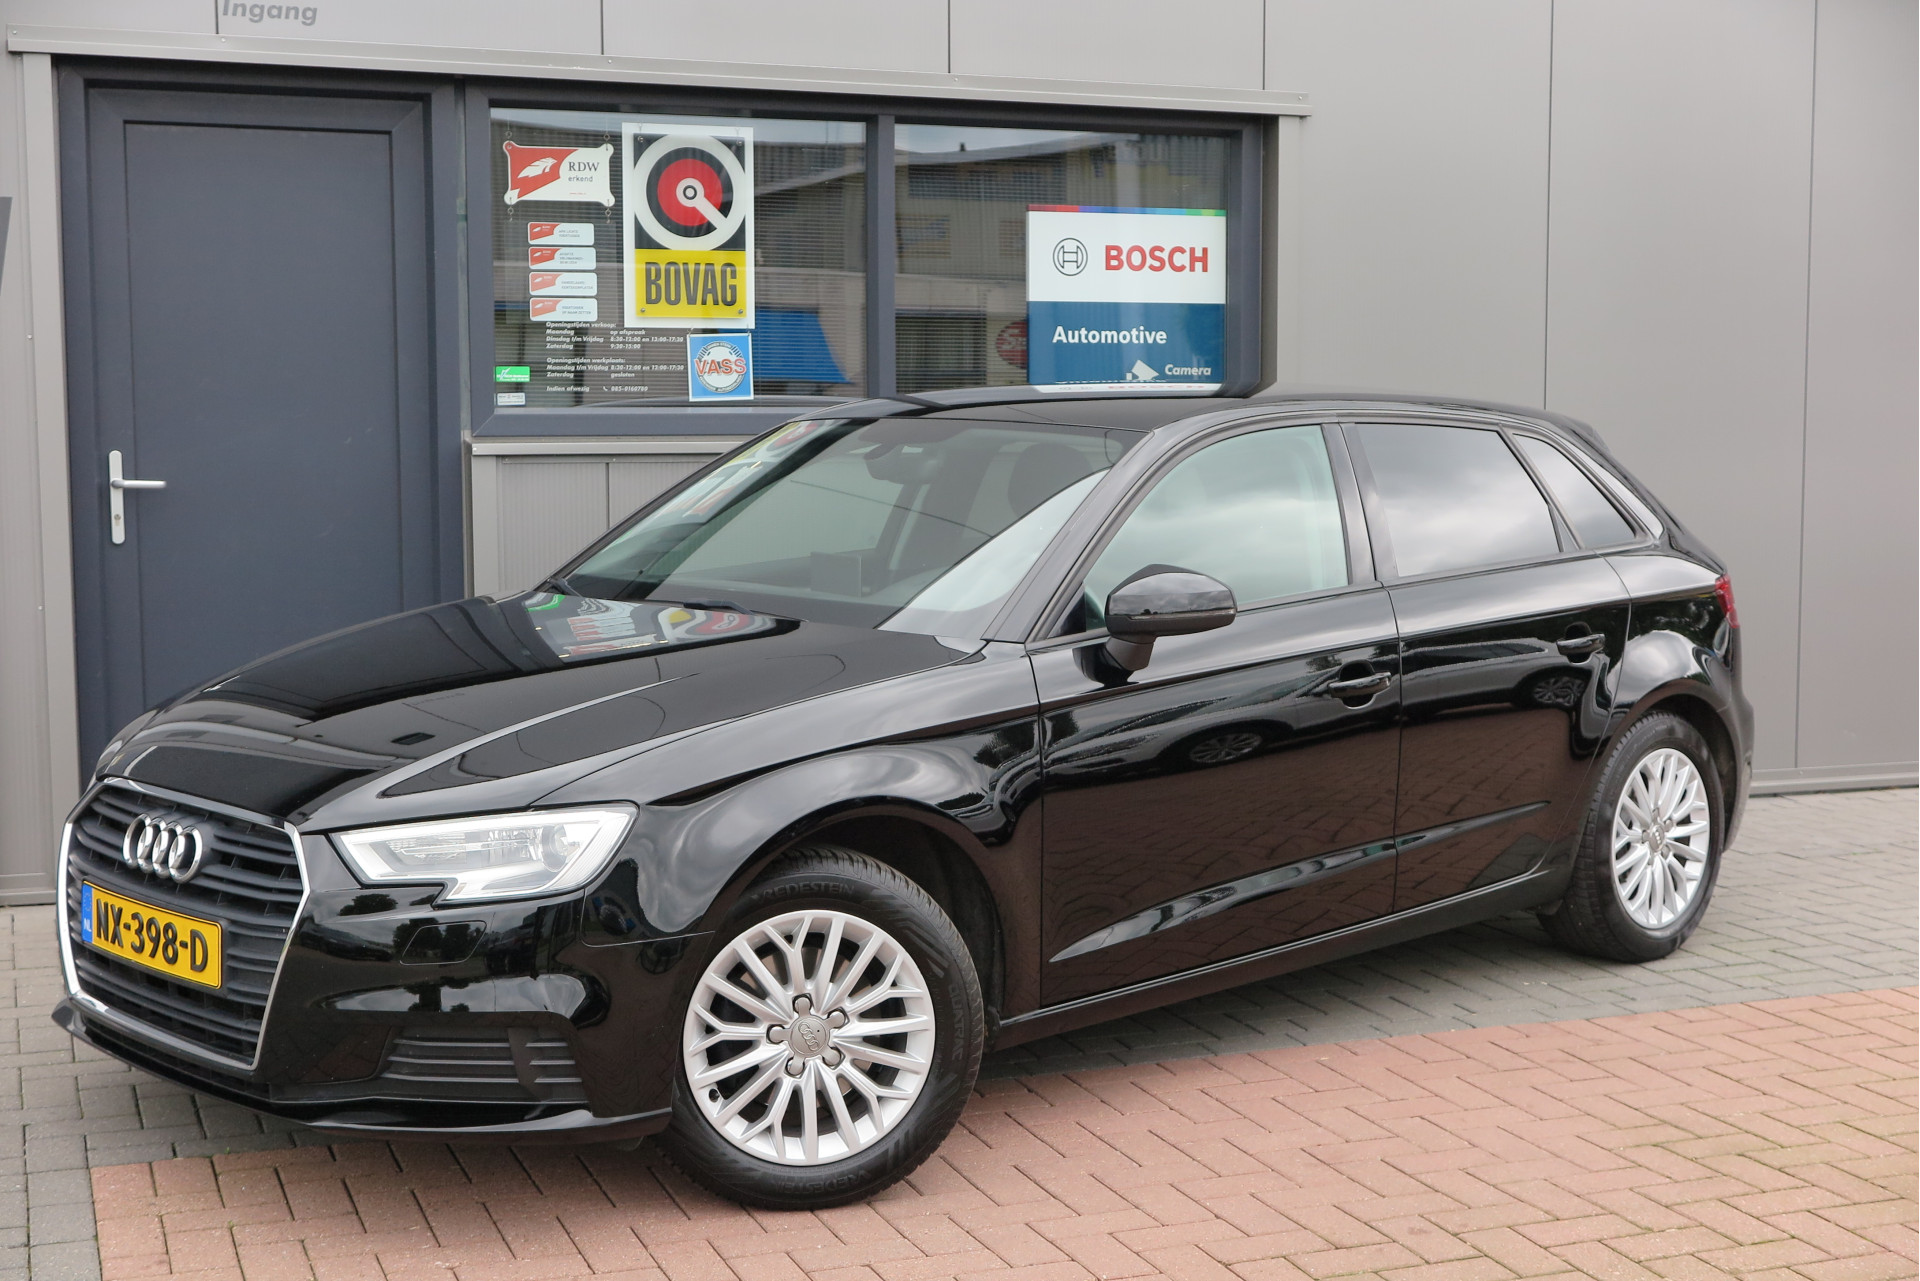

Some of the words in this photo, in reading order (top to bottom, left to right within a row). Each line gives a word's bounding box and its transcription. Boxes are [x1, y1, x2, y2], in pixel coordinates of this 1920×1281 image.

[222, 0, 318, 26] Ingang
[568, 161, 600, 172] RDW
[1105, 245, 1209, 273] BOSCH
[645, 261, 738, 307] BOVAG
[1052, 325, 1168, 344] Automotive
[694, 358, 747, 376] VASS
[1164, 364, 1212, 376] Camera
[83, 917, 92, 932] NL
[96, 898, 209, 973] NX-398-D
